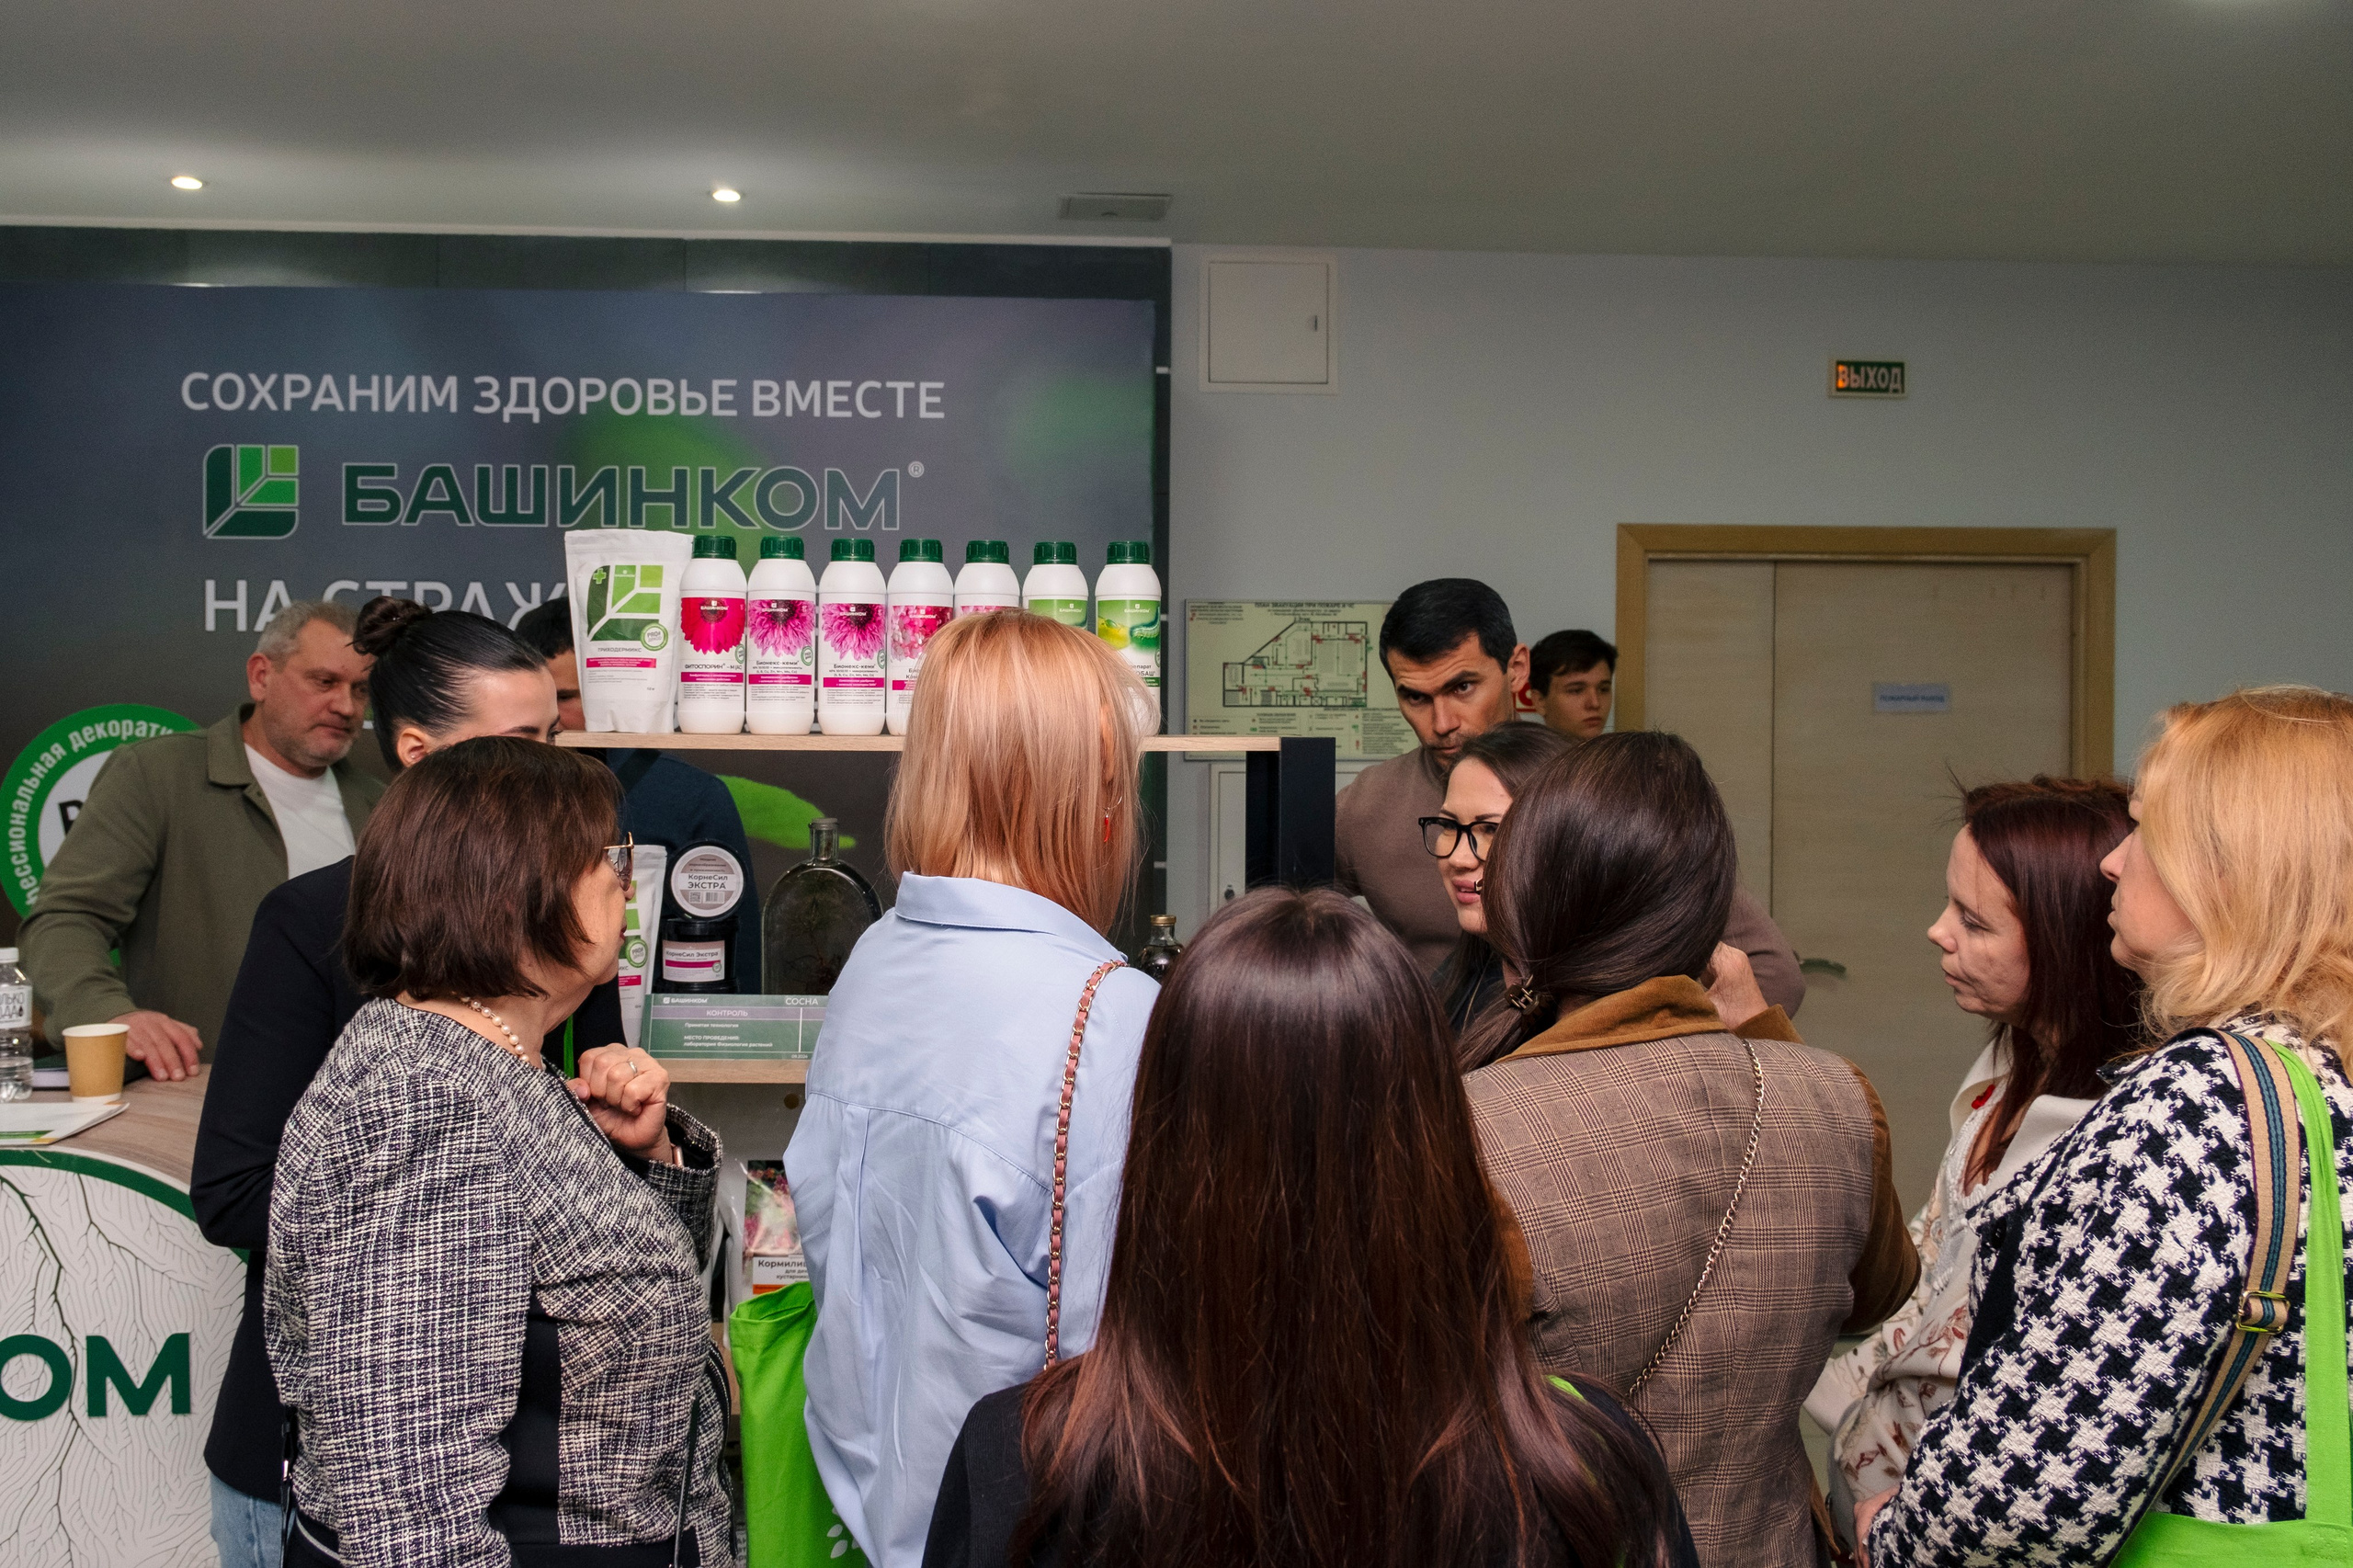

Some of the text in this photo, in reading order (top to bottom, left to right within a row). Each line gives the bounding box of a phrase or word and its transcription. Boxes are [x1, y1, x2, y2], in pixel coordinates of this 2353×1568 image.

[1836, 364, 1902, 394] ВЫХОД
[181, 372, 945, 423] СОХРАНИМ ЗДОРОВЬЕ ВМЕСТЕ
[205, 579, 292, 631] НА
[688, 881, 726, 890] ЭКСТРА
[0, 992, 25, 1006] ЛЬКО
[785, 997, 819, 1006] СОСНА
[758, 1260, 806, 1269] Кормили
